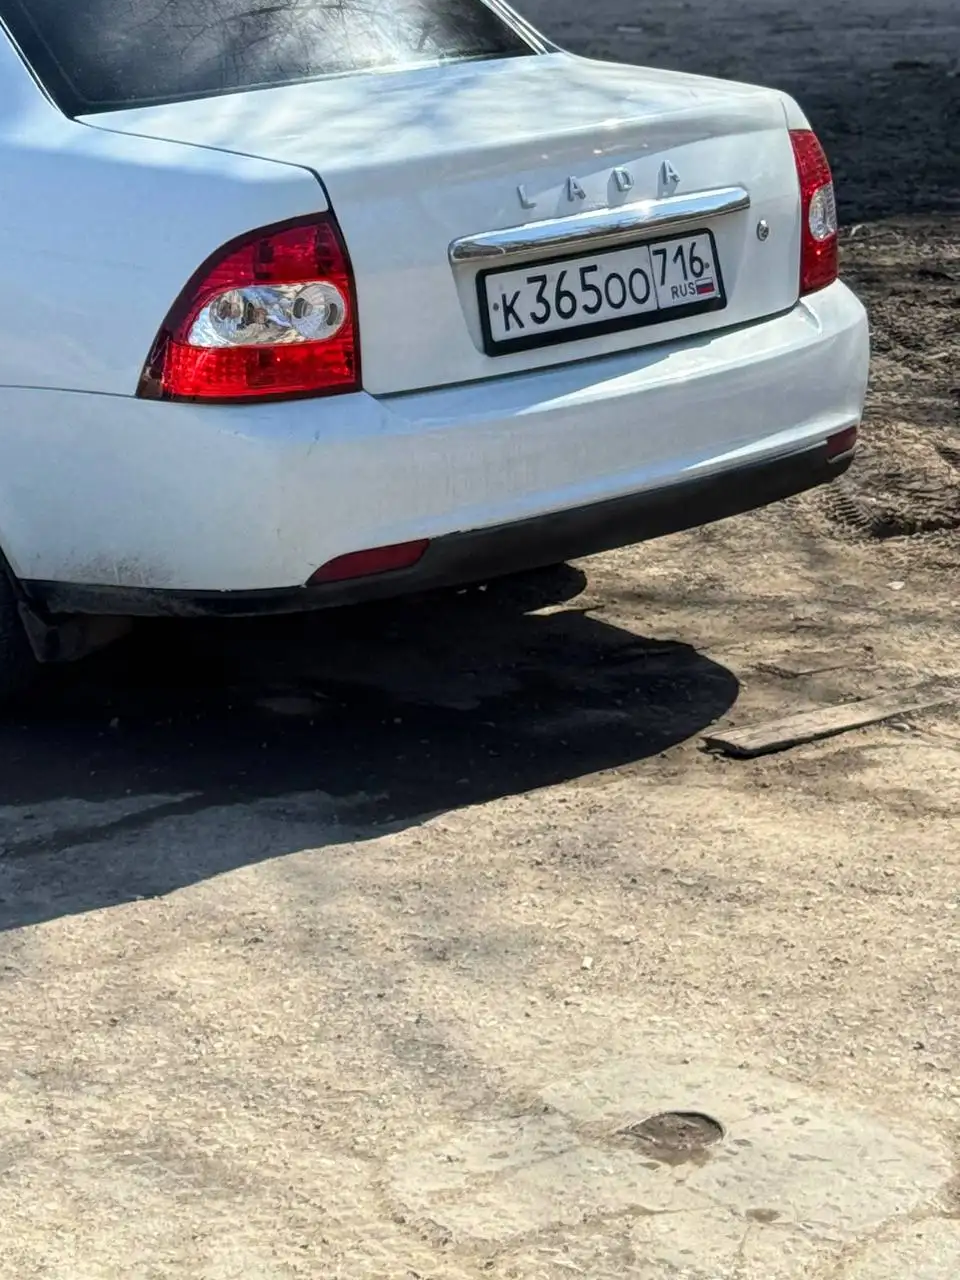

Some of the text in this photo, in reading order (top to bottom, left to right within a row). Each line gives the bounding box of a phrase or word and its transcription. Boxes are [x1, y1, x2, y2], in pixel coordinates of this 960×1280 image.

[516, 159, 681, 209] LADA
[652, 241, 705, 287] 716
[670, 281, 696, 301] RUS
